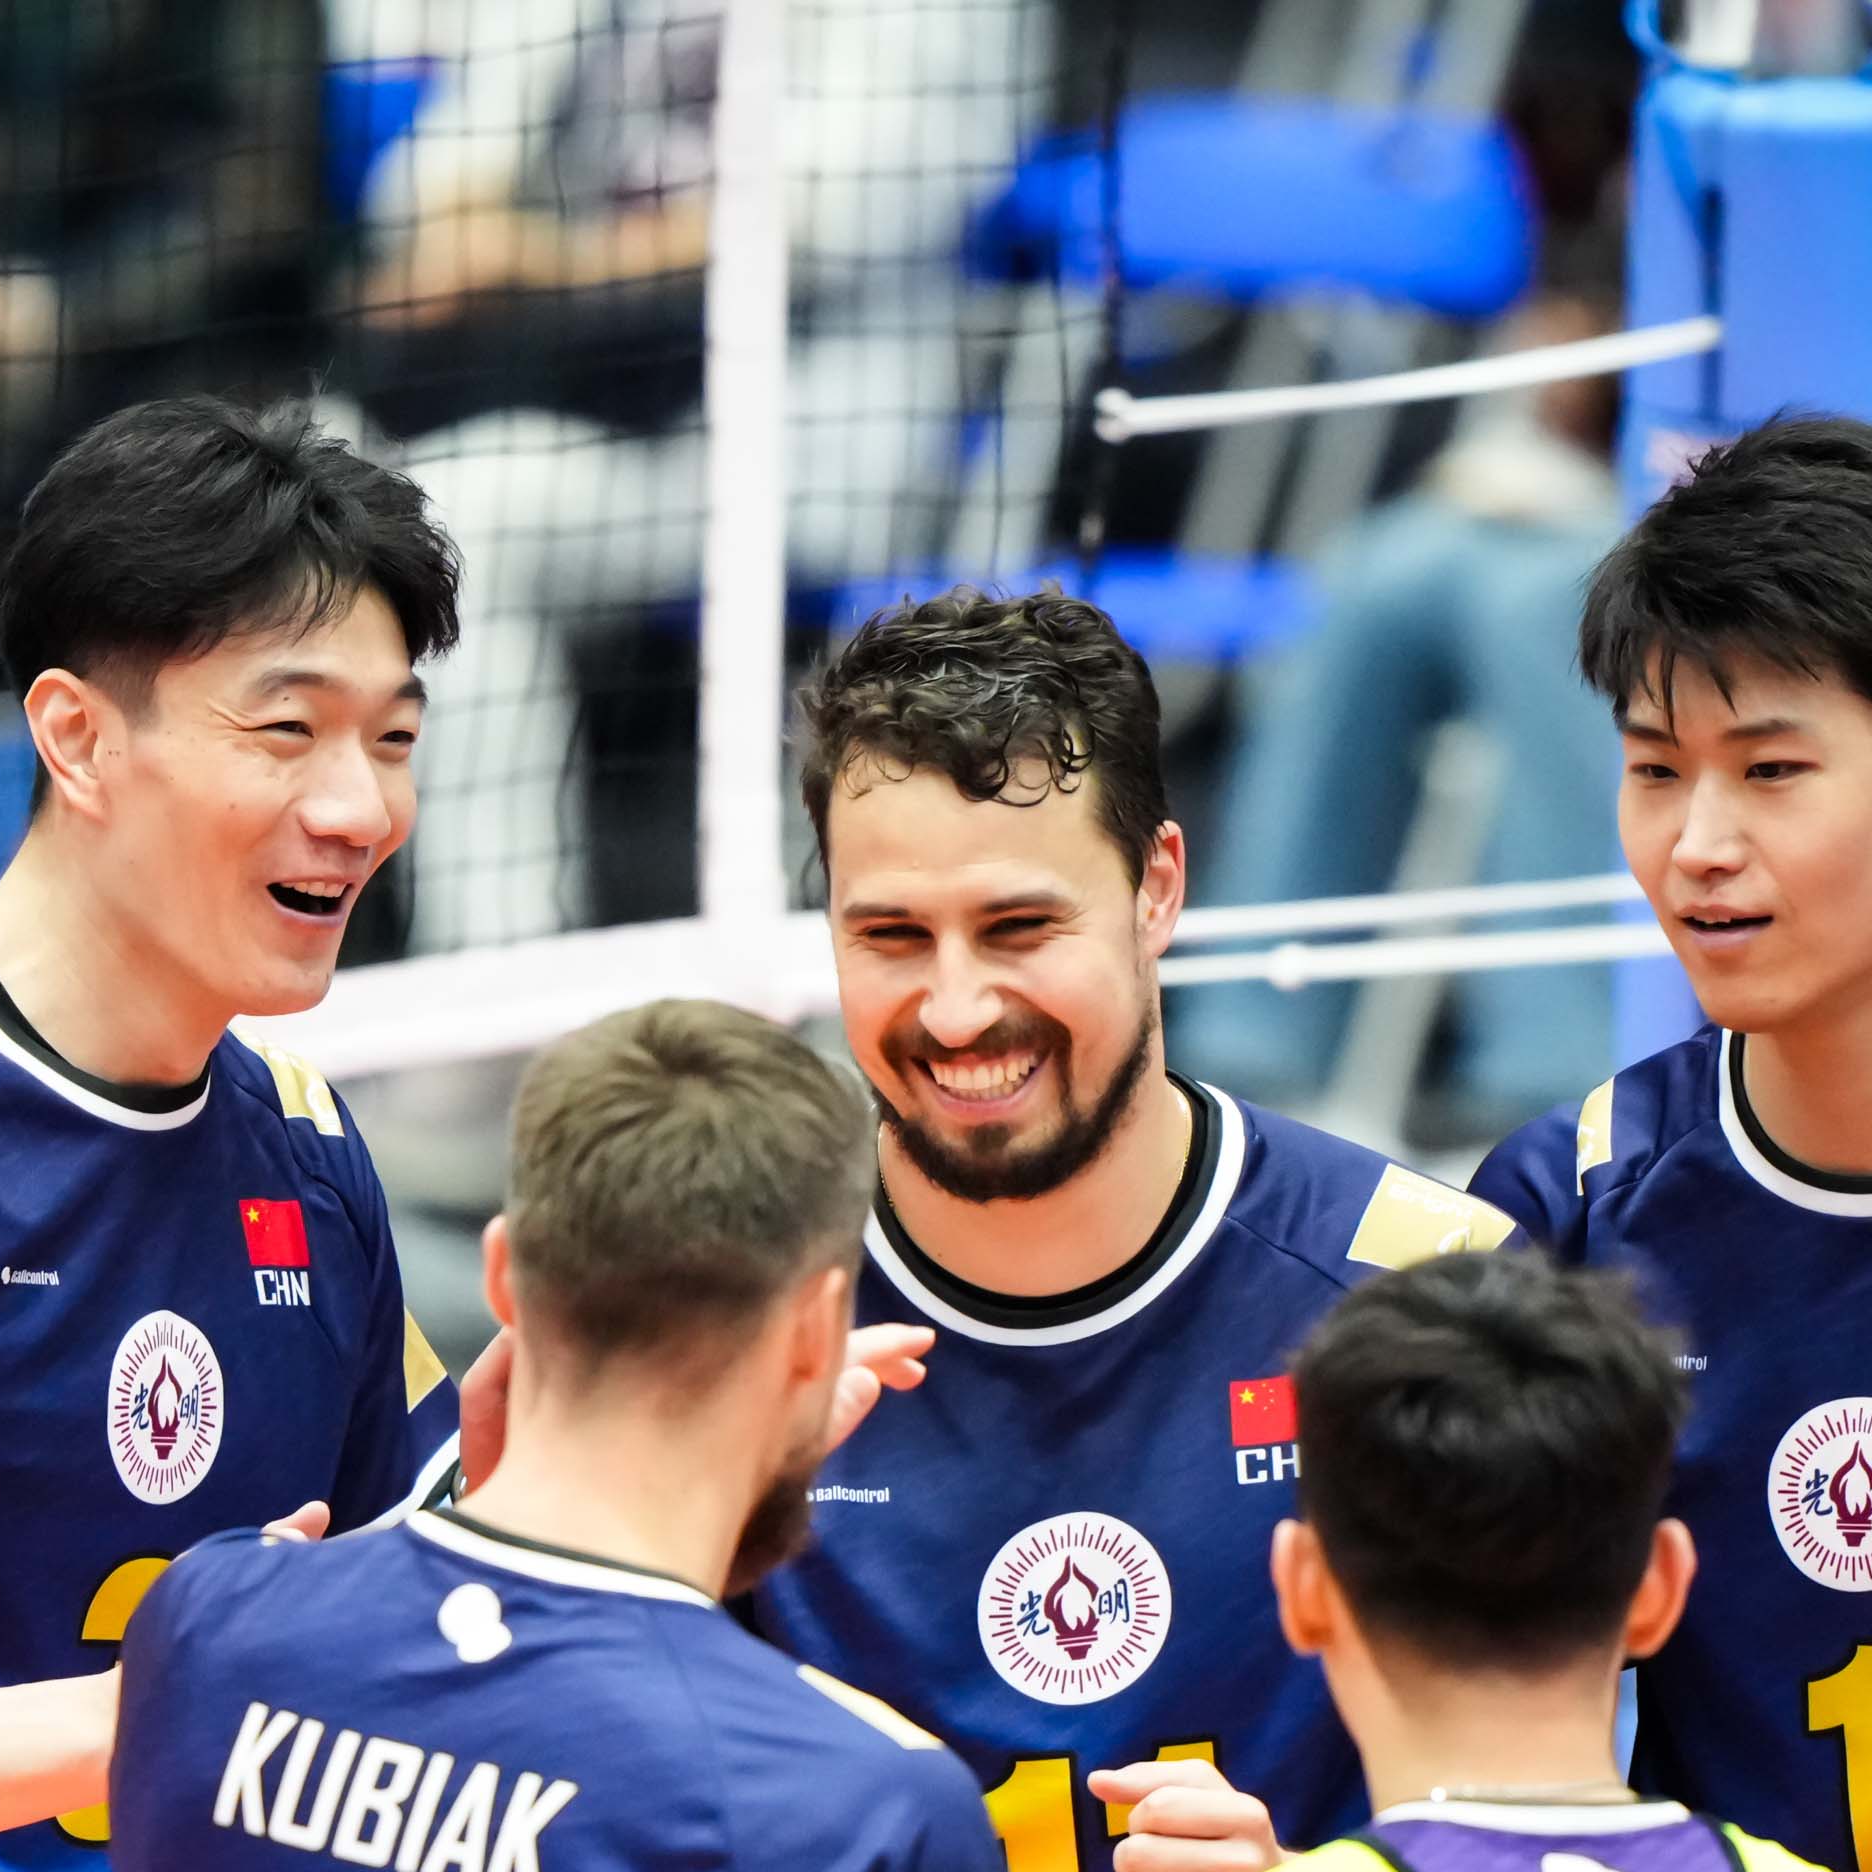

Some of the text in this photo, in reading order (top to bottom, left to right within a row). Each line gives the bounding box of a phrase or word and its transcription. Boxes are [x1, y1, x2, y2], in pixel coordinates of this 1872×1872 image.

[254, 1269, 311, 1306] CHN
[131, 1382, 199, 1431] 光明
[816, 1485, 890, 1503] Ballcontrol
[1015, 1577, 1131, 1637] 光明
